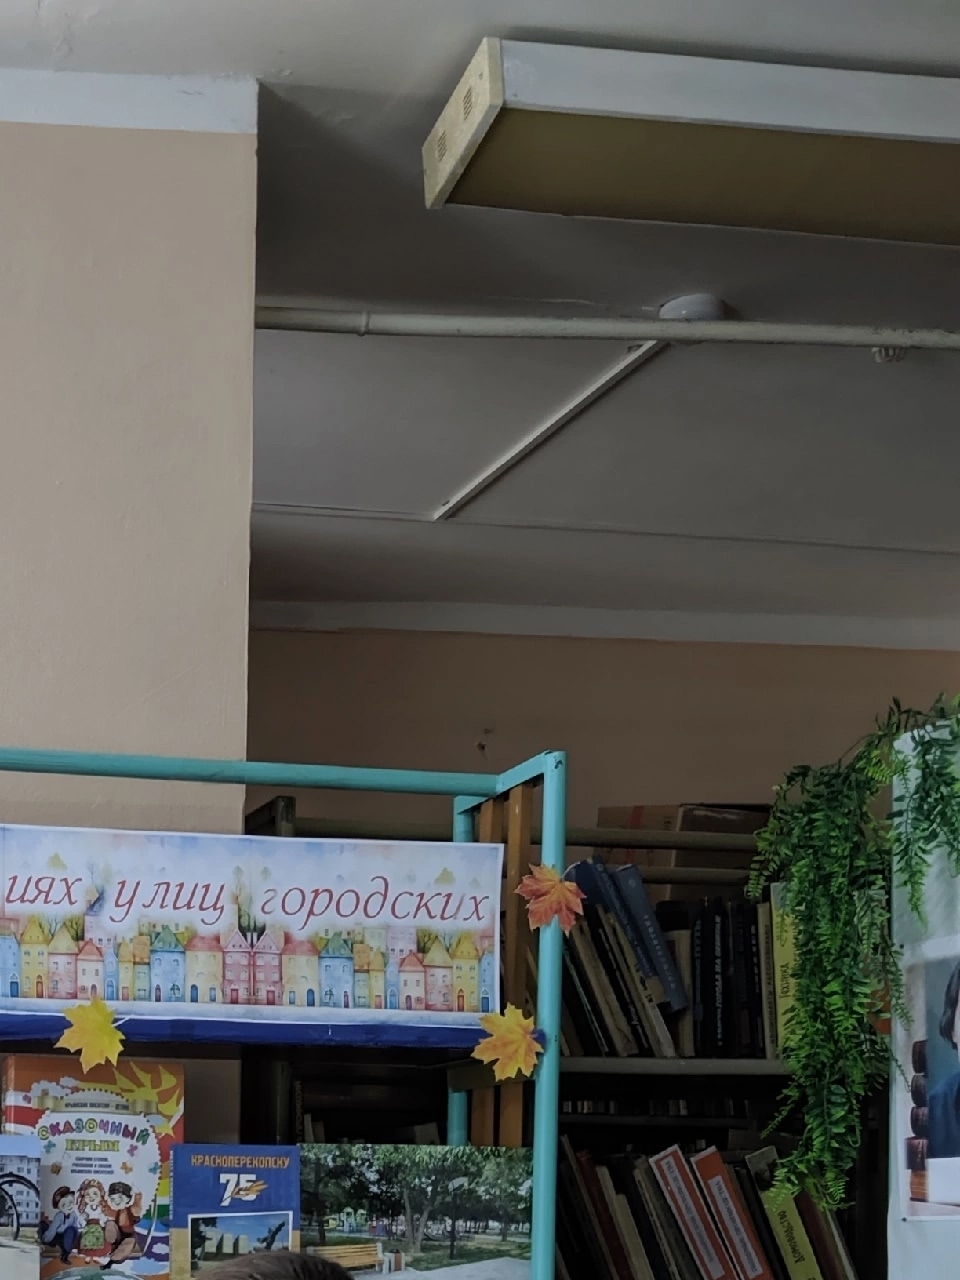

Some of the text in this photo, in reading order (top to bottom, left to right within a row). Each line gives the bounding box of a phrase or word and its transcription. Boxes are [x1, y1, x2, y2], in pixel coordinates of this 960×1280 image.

[112, 879, 226, 924] улиц
[259, 874, 490, 932] городских
[37, 1117, 151, 1146] СКАЗОЧНЫЙ
[65, 1139, 121, 1152] КРЫМ
[190, 1154, 290, 1169] КРАСНОПЕРЕКОПСКУ
[219, 1173, 258, 1207] 75
